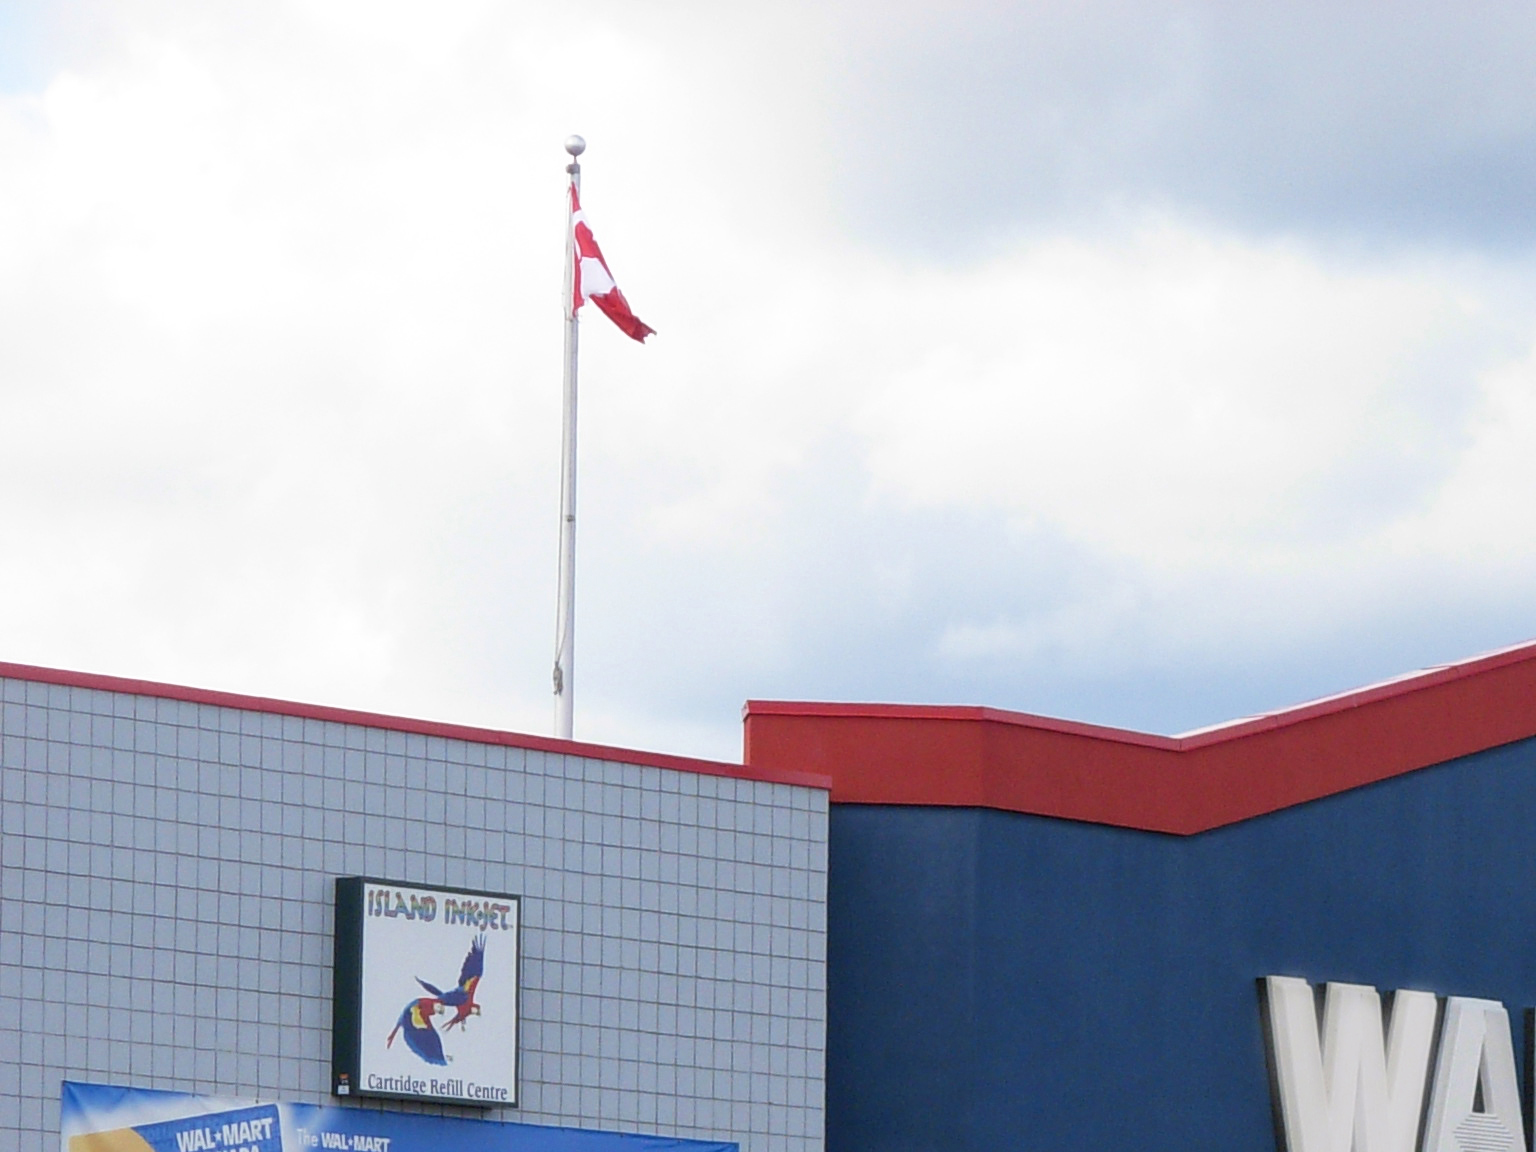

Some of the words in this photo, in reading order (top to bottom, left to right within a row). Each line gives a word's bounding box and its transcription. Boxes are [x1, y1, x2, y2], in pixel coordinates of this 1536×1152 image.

[368, 889, 437, 922] ISLAND
[367, 1073, 427, 1096] Cartridge
[430, 1078, 463, 1098] Refill
[467, 1082, 508, 1101] Centre
[297, 1129, 319, 1148] The
